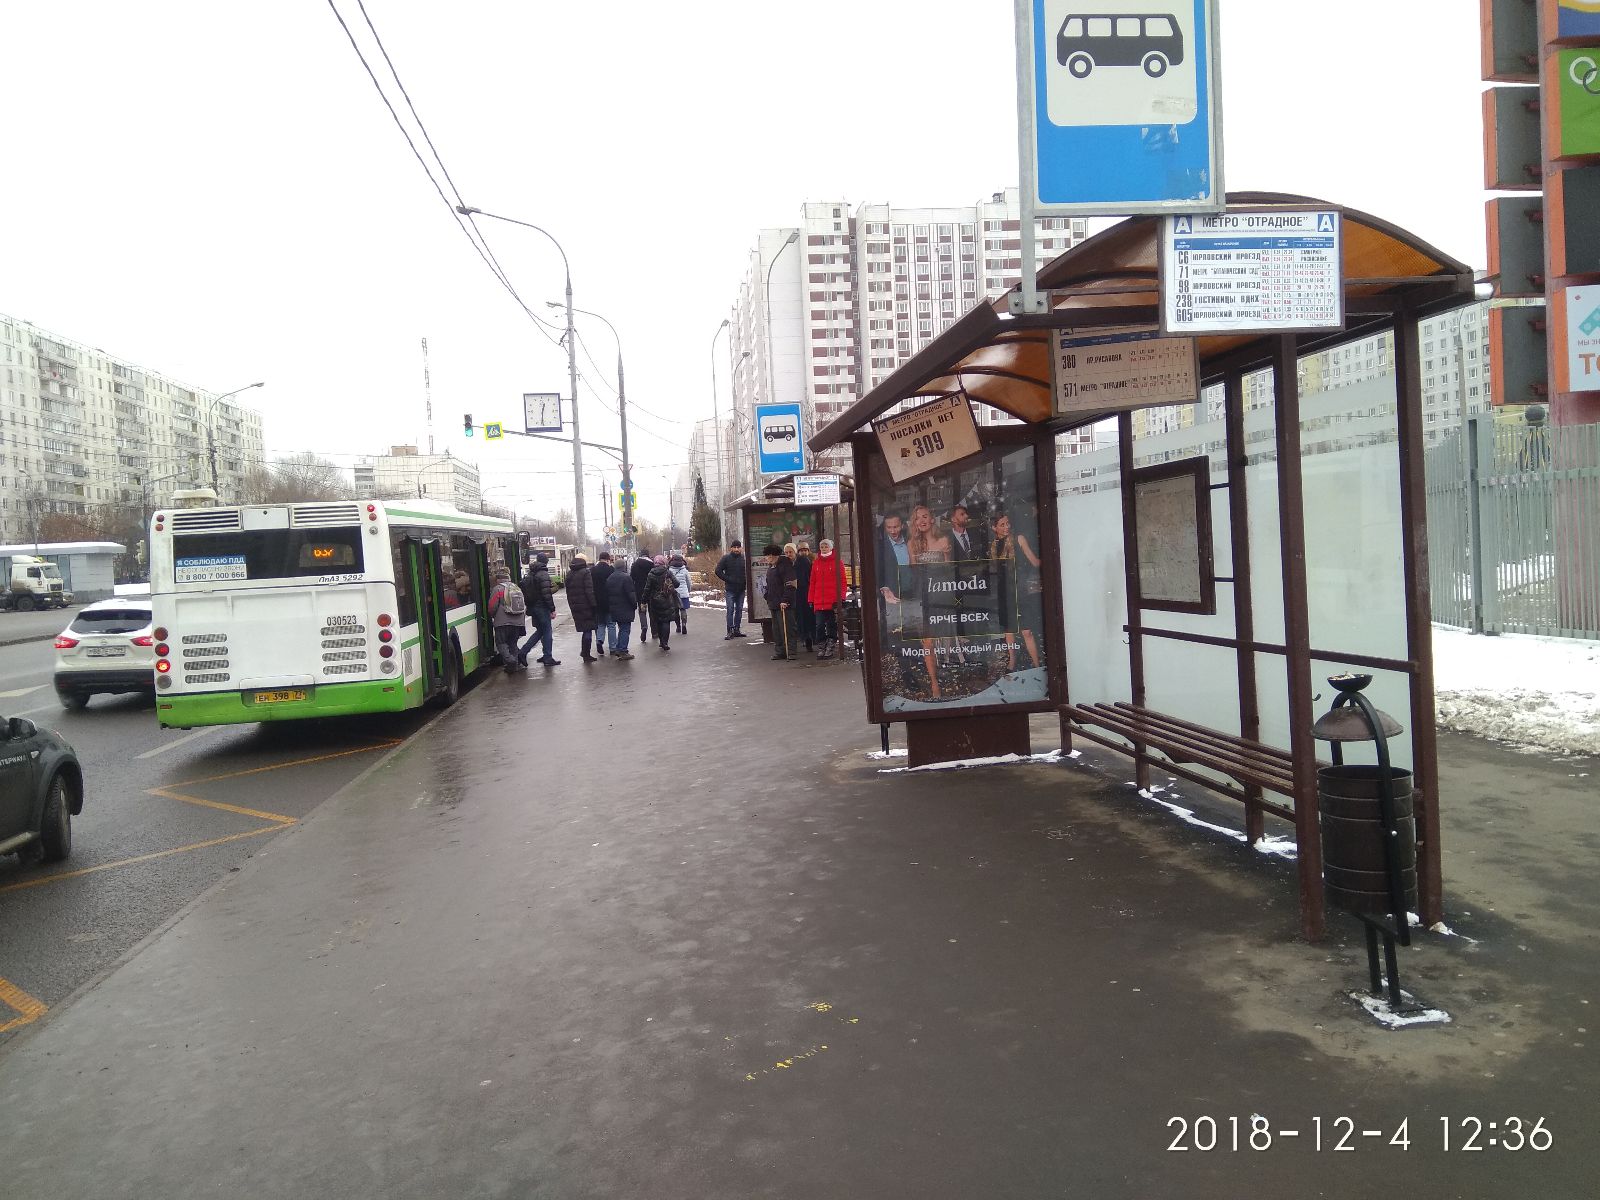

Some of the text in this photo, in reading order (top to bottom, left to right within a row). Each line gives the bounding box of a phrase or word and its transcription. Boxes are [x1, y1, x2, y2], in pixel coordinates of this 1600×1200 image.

[1202, 216, 1239, 228] МЕТРО
[1178, 250, 1189, 265] С6
[1179, 265, 1189, 279] 71
[1178, 280, 1190, 294] 98
[1176, 294, 1259, 308] 238 ГОСТИНИЦЫ ВДНХ
[1176, 309, 1193, 321] 605
[1236, 310, 1260, 319] ПРОЕЗД
[1063, 382, 1077, 398] 571
[890, 410, 954, 441] ПОСАДКИ НЕТ
[912, 430, 945, 458] 309
[183, 558, 227, 566] СОБЛЮДАЮ
[228, 556, 245, 565] ПДД
[927, 576, 987, 593] lamoda
[326, 614, 357, 626] 030523
[929, 612, 990, 625] ЯРЧЕ ВСЕХ
[902, 642, 1021, 658] Мода на каждый день
[272, 691, 289, 700] 398
